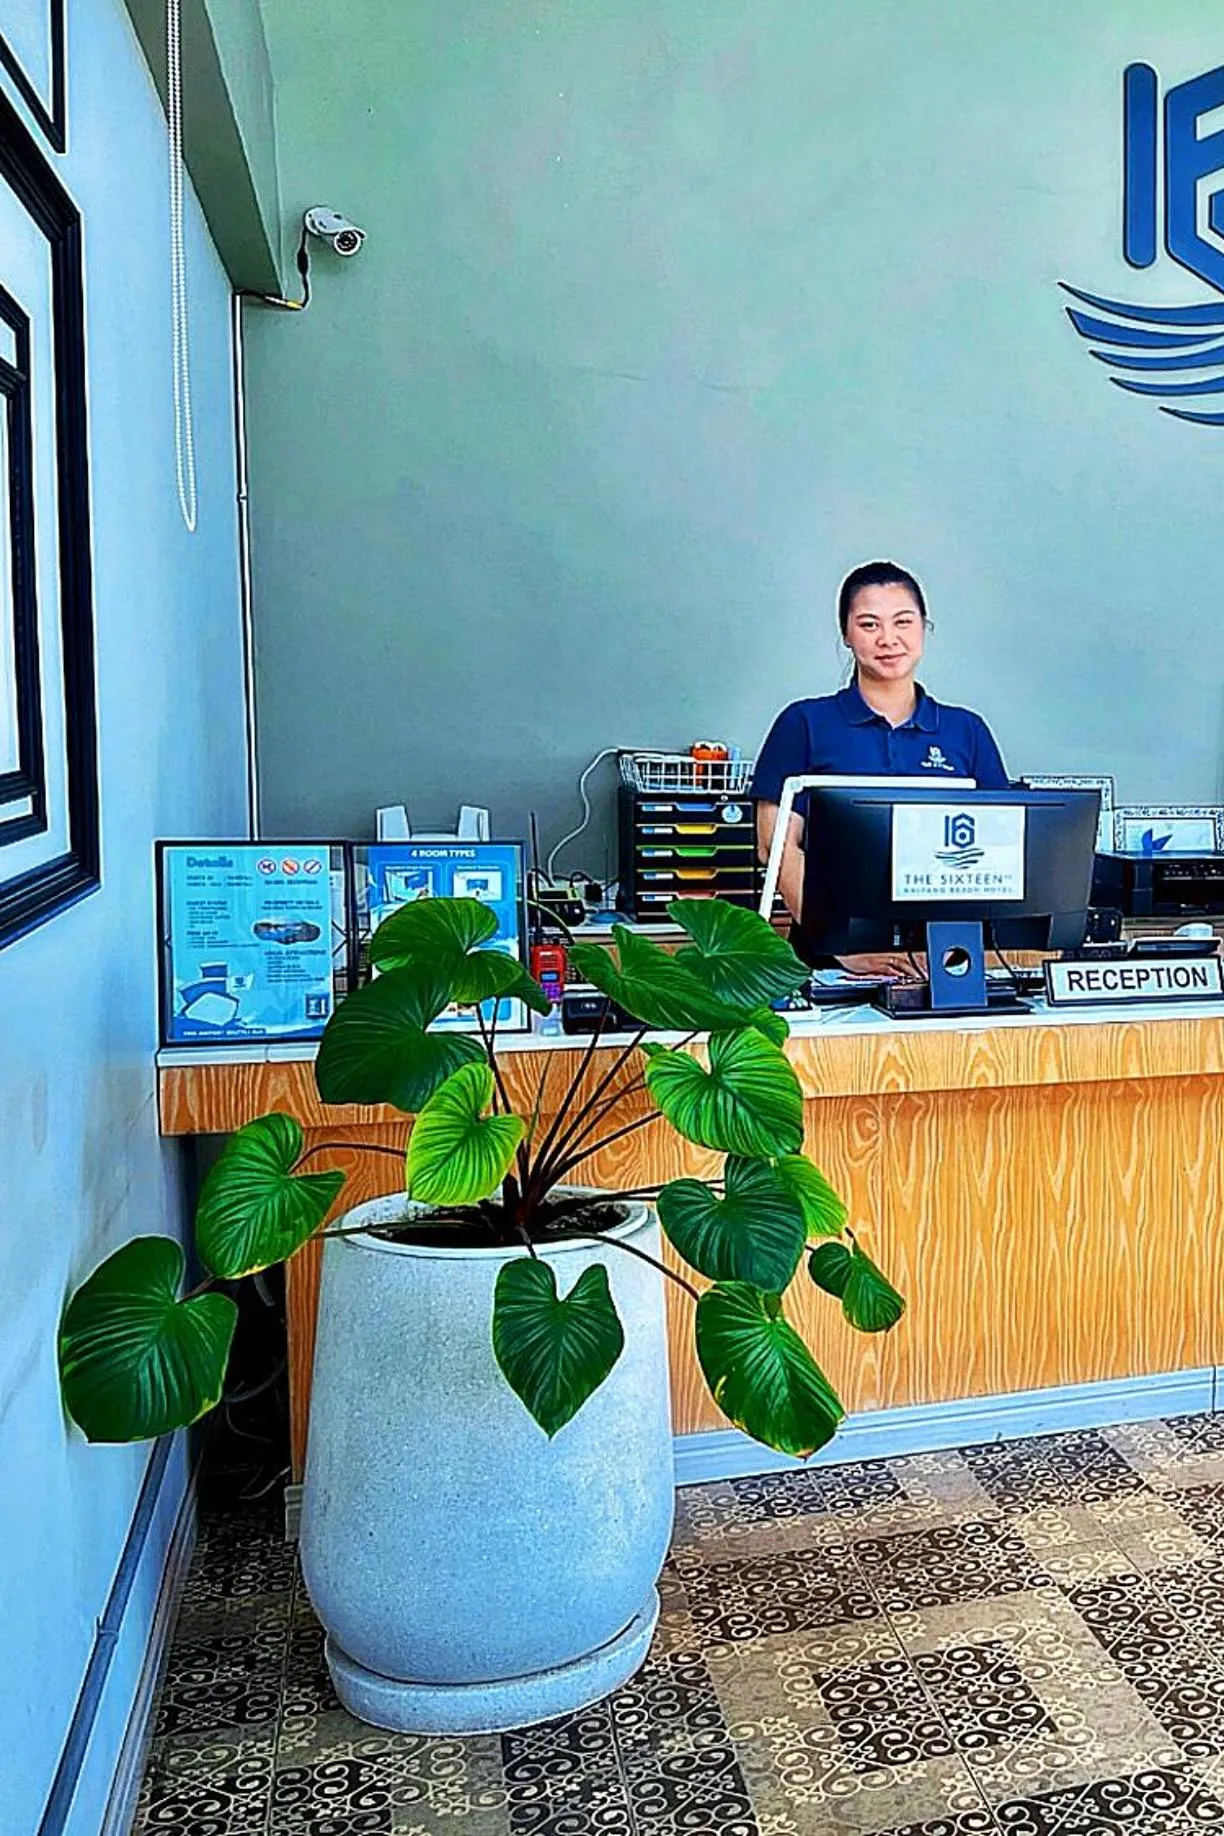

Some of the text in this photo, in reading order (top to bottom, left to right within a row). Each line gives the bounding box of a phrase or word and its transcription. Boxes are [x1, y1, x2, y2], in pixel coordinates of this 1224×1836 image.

[419, 849, 448, 858] ROOM
[904, 874, 933, 885] THE
[1066, 966, 1209, 993] RECEPTION
